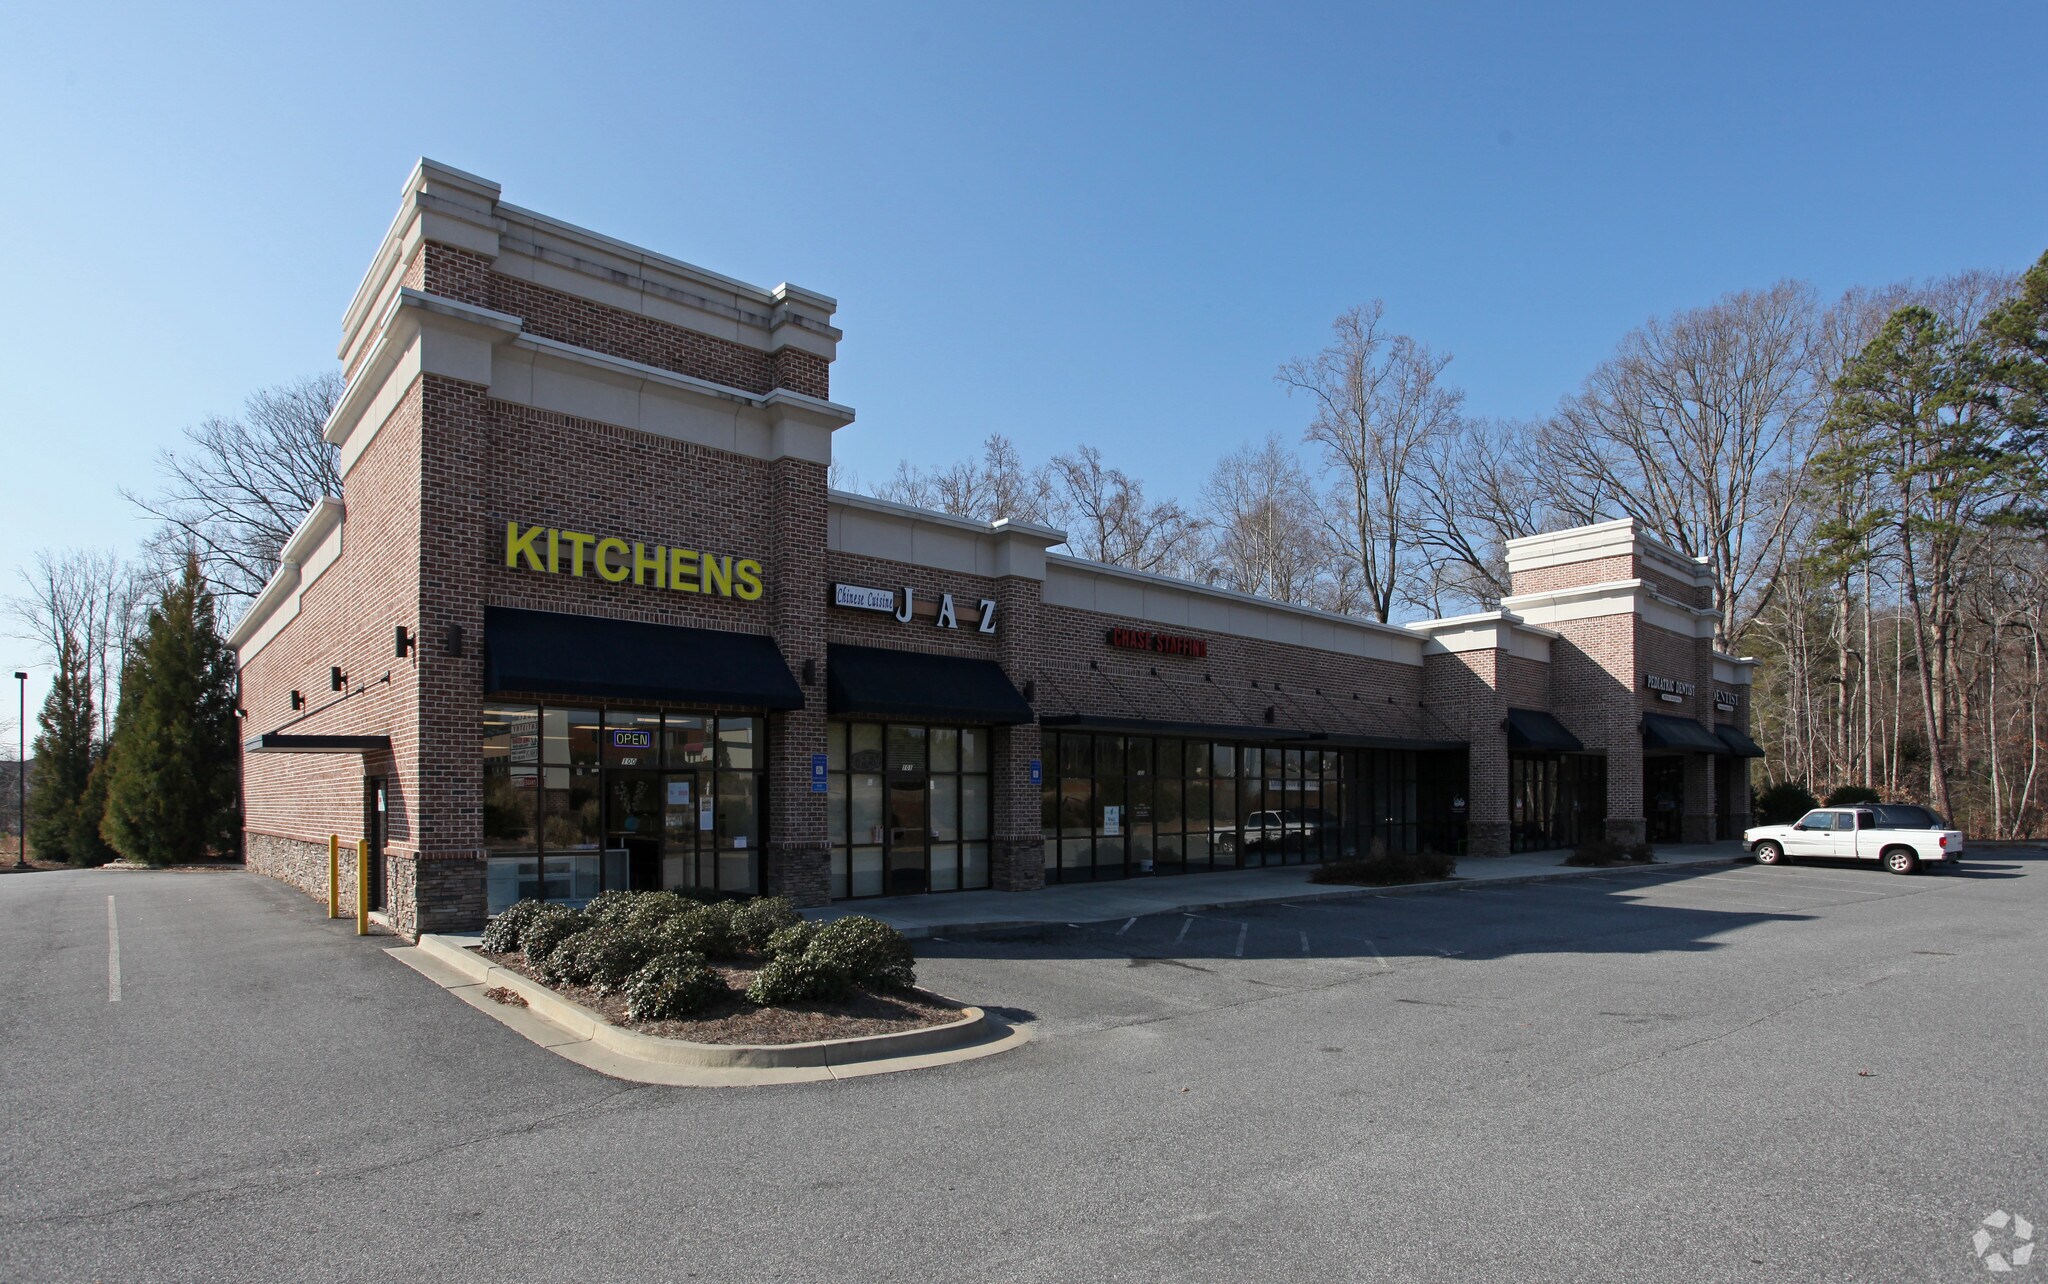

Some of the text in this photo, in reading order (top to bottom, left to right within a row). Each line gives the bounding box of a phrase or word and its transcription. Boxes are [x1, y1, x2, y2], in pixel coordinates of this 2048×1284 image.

[506, 521, 763, 600] KITCHENS
[837, 588, 894, 611] Chinese Cuisine
[1113, 627, 1153, 650] CHASE
[1648, 675, 1696, 697] PEDIATRIC DENTIST
[616, 733, 648, 745] OPEN
[622, 757, 637, 765] 100
